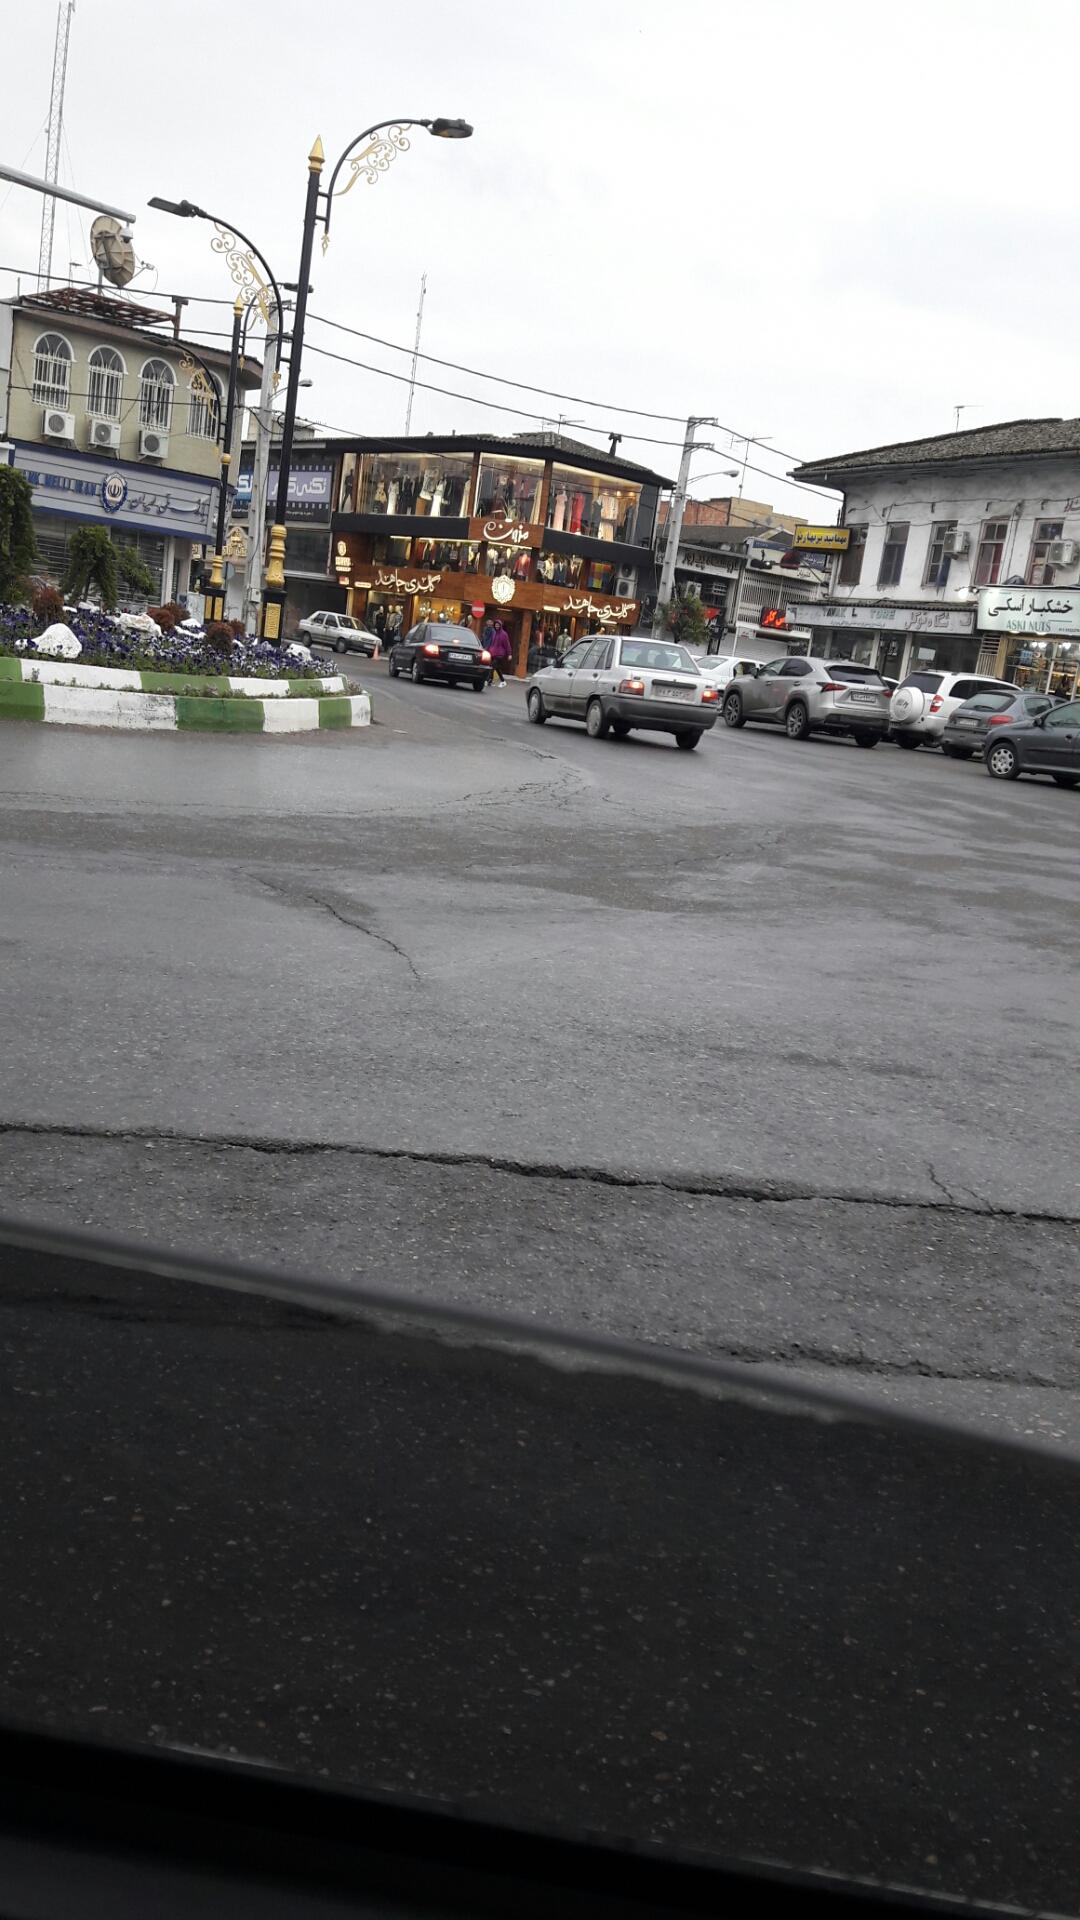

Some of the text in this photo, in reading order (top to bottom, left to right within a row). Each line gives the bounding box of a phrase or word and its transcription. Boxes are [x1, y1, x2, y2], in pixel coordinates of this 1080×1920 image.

[483, 521, 529, 543] مزون
[1025, 597, 1074, 617] خشکبار
[1006, 619, 1026, 631] ASKI
[1028, 620, 1051, 633] NUTS
